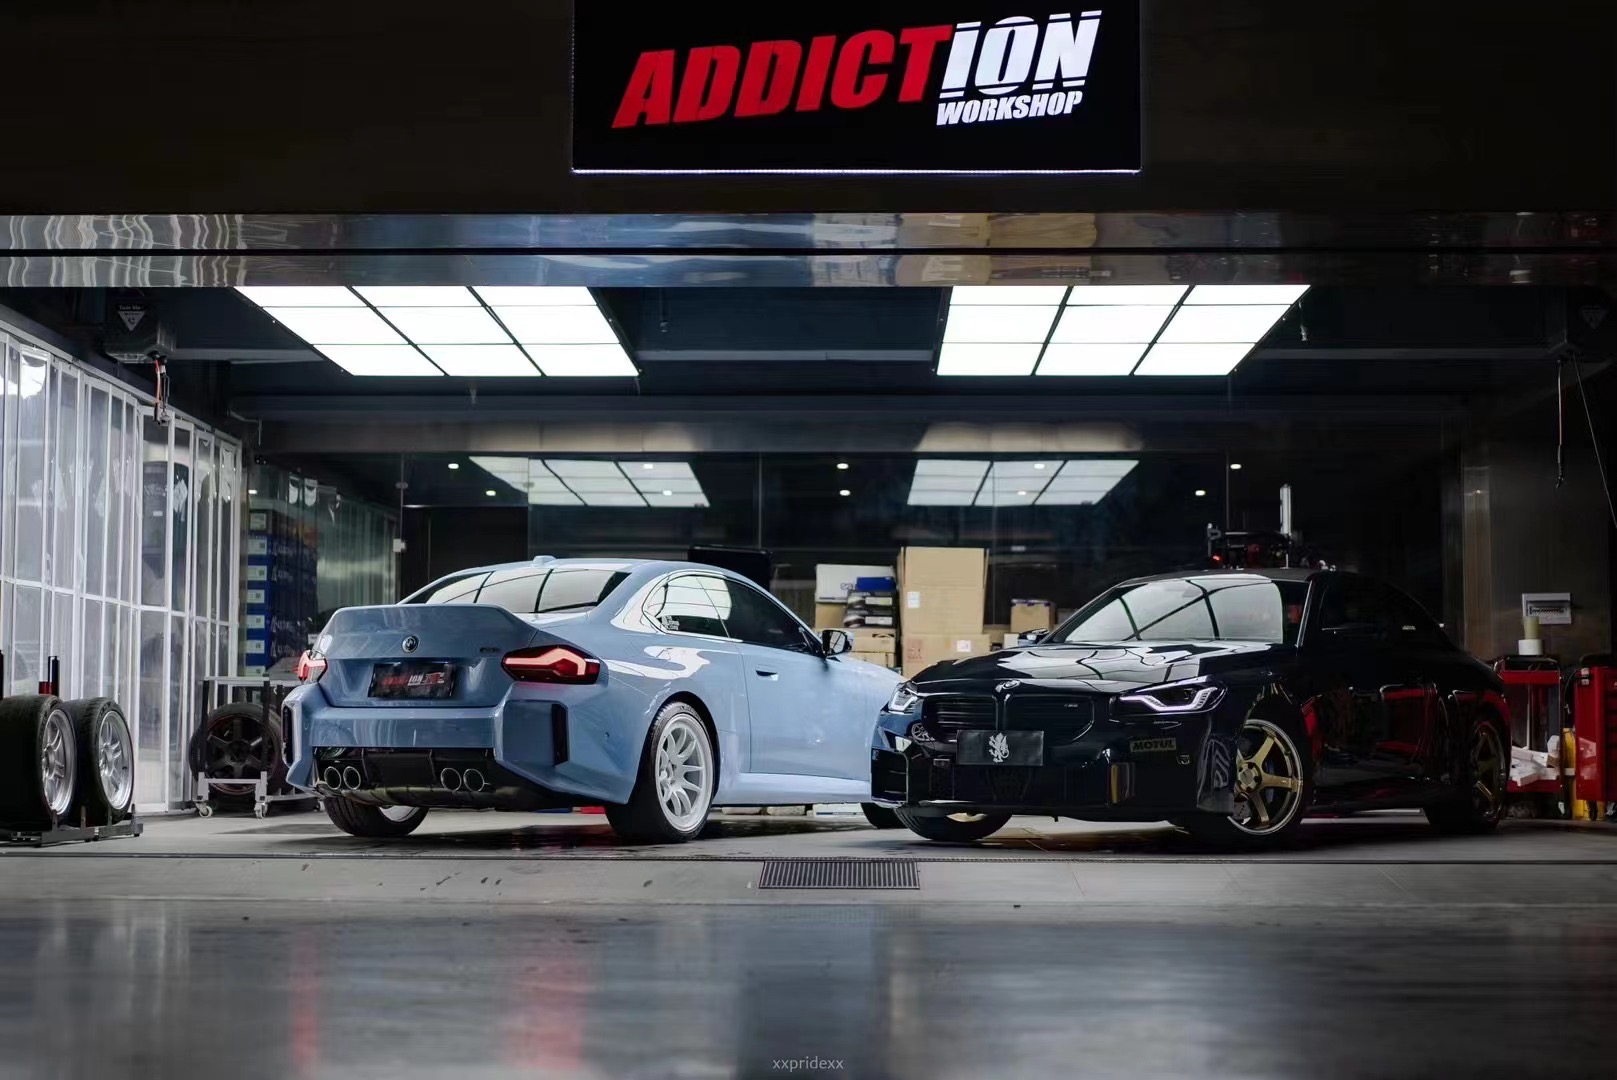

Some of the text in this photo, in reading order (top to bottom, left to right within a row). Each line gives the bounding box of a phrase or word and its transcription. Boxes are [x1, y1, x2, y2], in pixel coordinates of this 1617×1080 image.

[612, 10, 1102, 128] ADDICTION
[936, 91, 1083, 126] WORKSHOP
[1132, 739, 1174, 751] MOTUL
